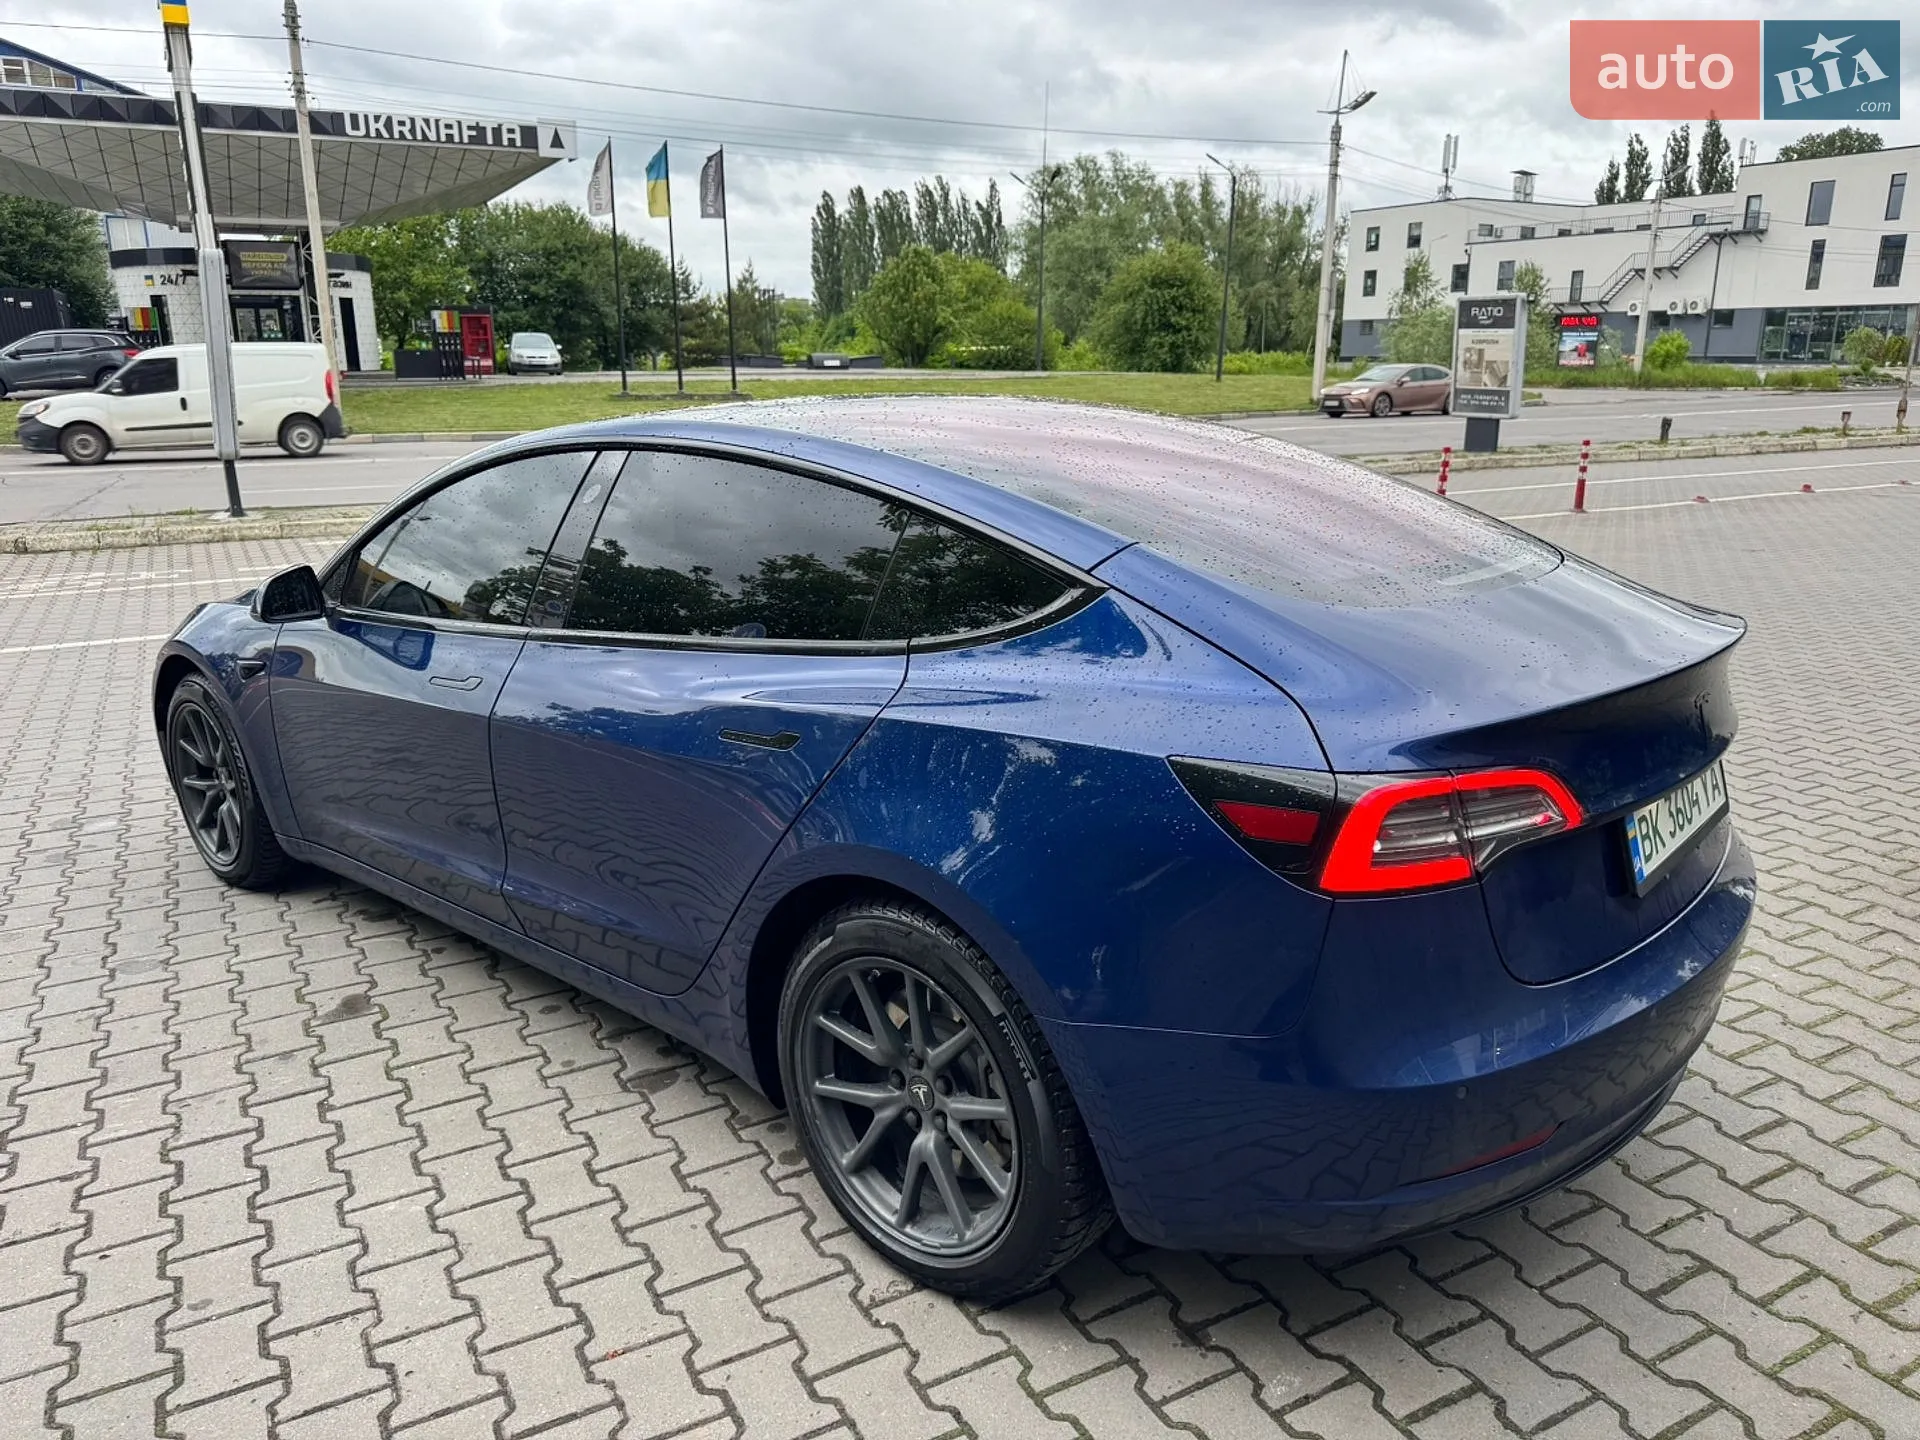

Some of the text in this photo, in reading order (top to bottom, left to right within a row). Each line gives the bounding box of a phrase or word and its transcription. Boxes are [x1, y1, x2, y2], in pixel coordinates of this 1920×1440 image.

[343, 111, 522, 147] UKRNAFTA
[1471, 306, 1504, 317] RATIO
[1637, 803, 1666, 864] BK
